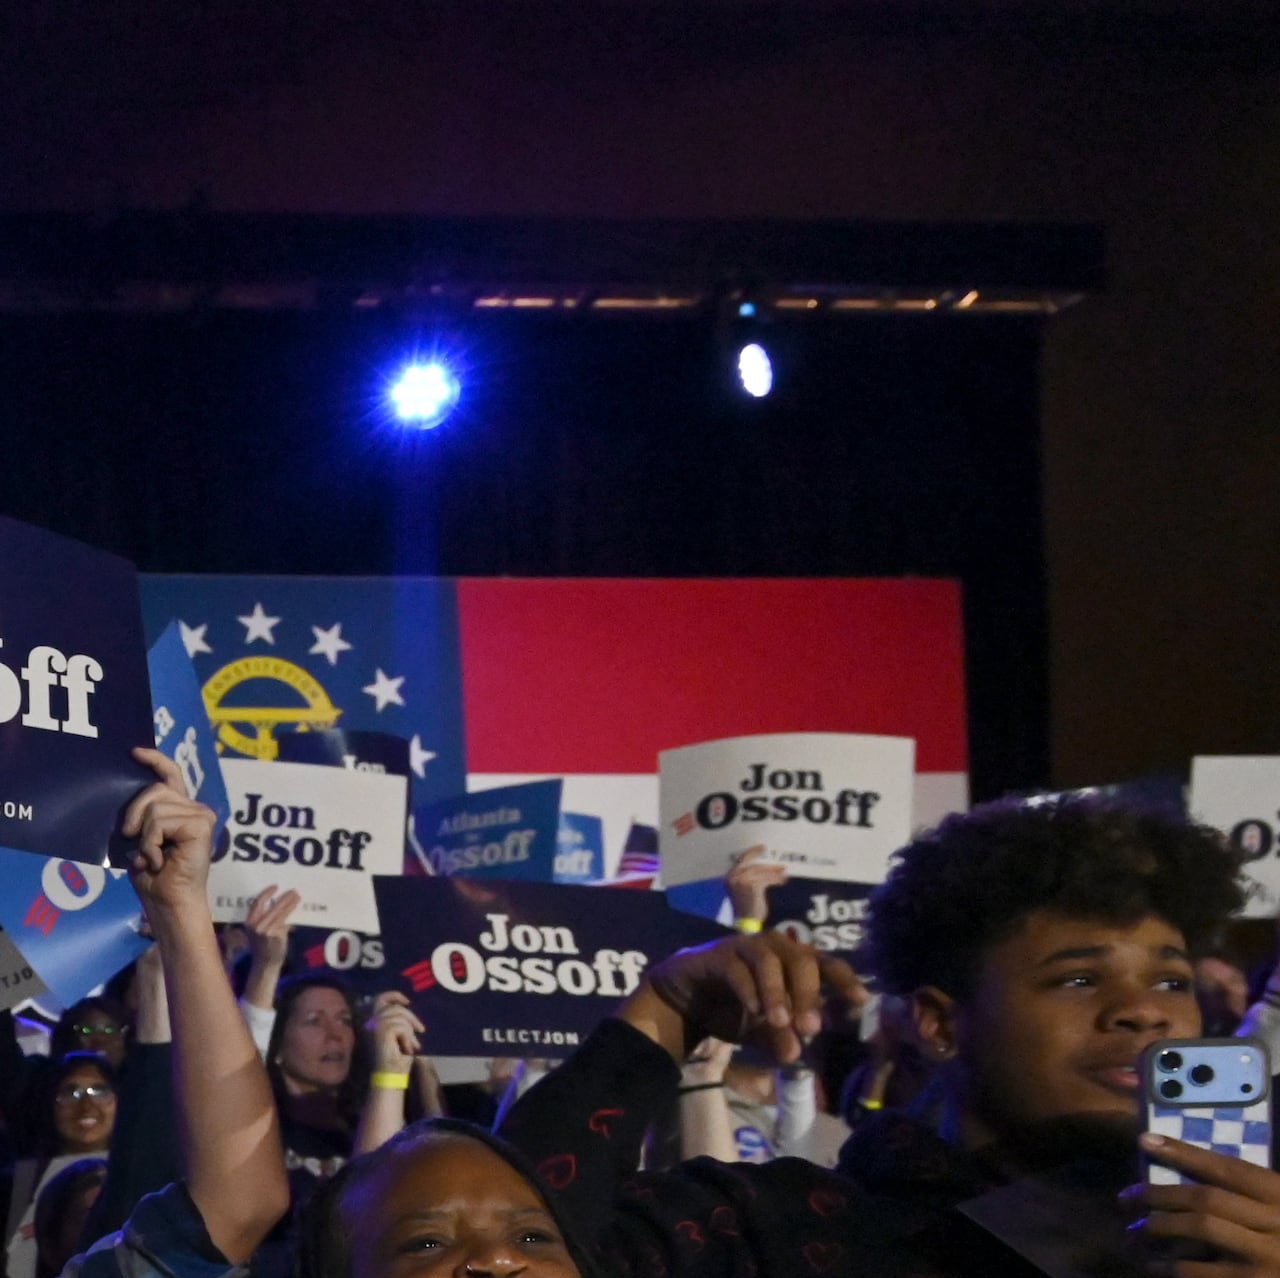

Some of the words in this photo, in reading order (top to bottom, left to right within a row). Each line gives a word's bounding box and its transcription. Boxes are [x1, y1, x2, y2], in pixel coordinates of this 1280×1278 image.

[741, 764, 823, 792] Jon
[234, 793, 316, 830] Jon
[696, 791, 881, 831] Ossoff
[480, 913, 578, 954] Jon
[430, 942, 648, 997] Ossoff
[483, 1028, 579, 1045] ELECTJON
